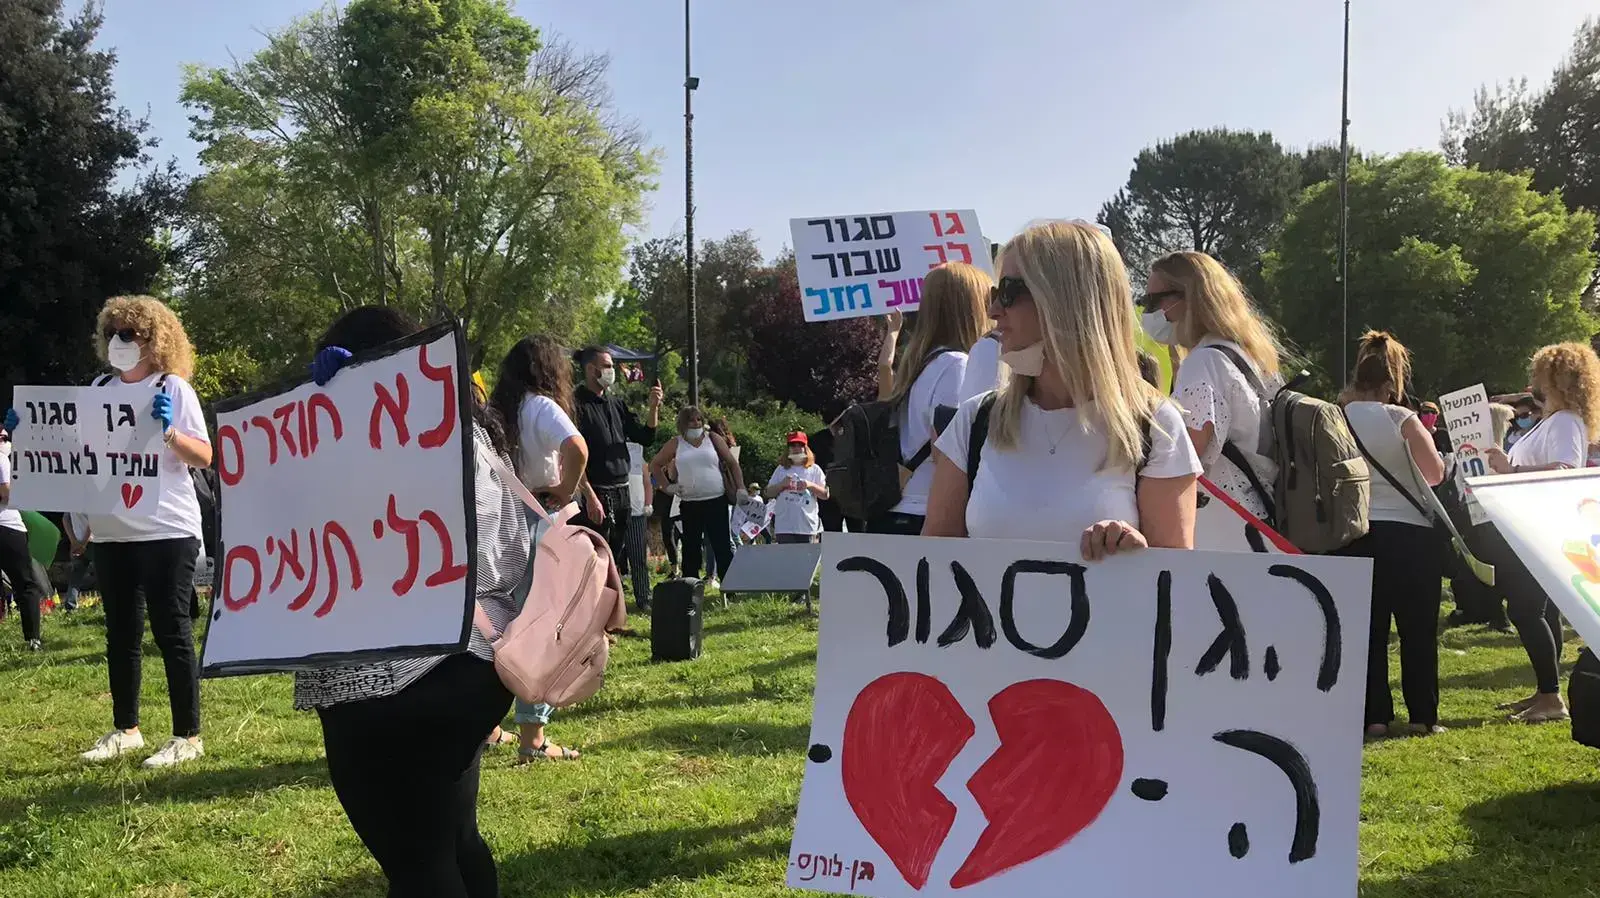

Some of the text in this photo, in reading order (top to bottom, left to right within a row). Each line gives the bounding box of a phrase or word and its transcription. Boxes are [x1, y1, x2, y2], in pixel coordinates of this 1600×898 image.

[807, 212, 965, 243] גן סגור
[811, 247, 901, 278] שבור
[805, 283, 873, 315] מזל
[26, 402, 136, 432] גן סגור
[218, 344, 456, 486] לא חוזרים
[69, 444, 98, 475] לא
[105, 452, 158, 477] עתיד
[373, 493, 468, 597] בלי
[836, 556, 1342, 732] הגן סגור
